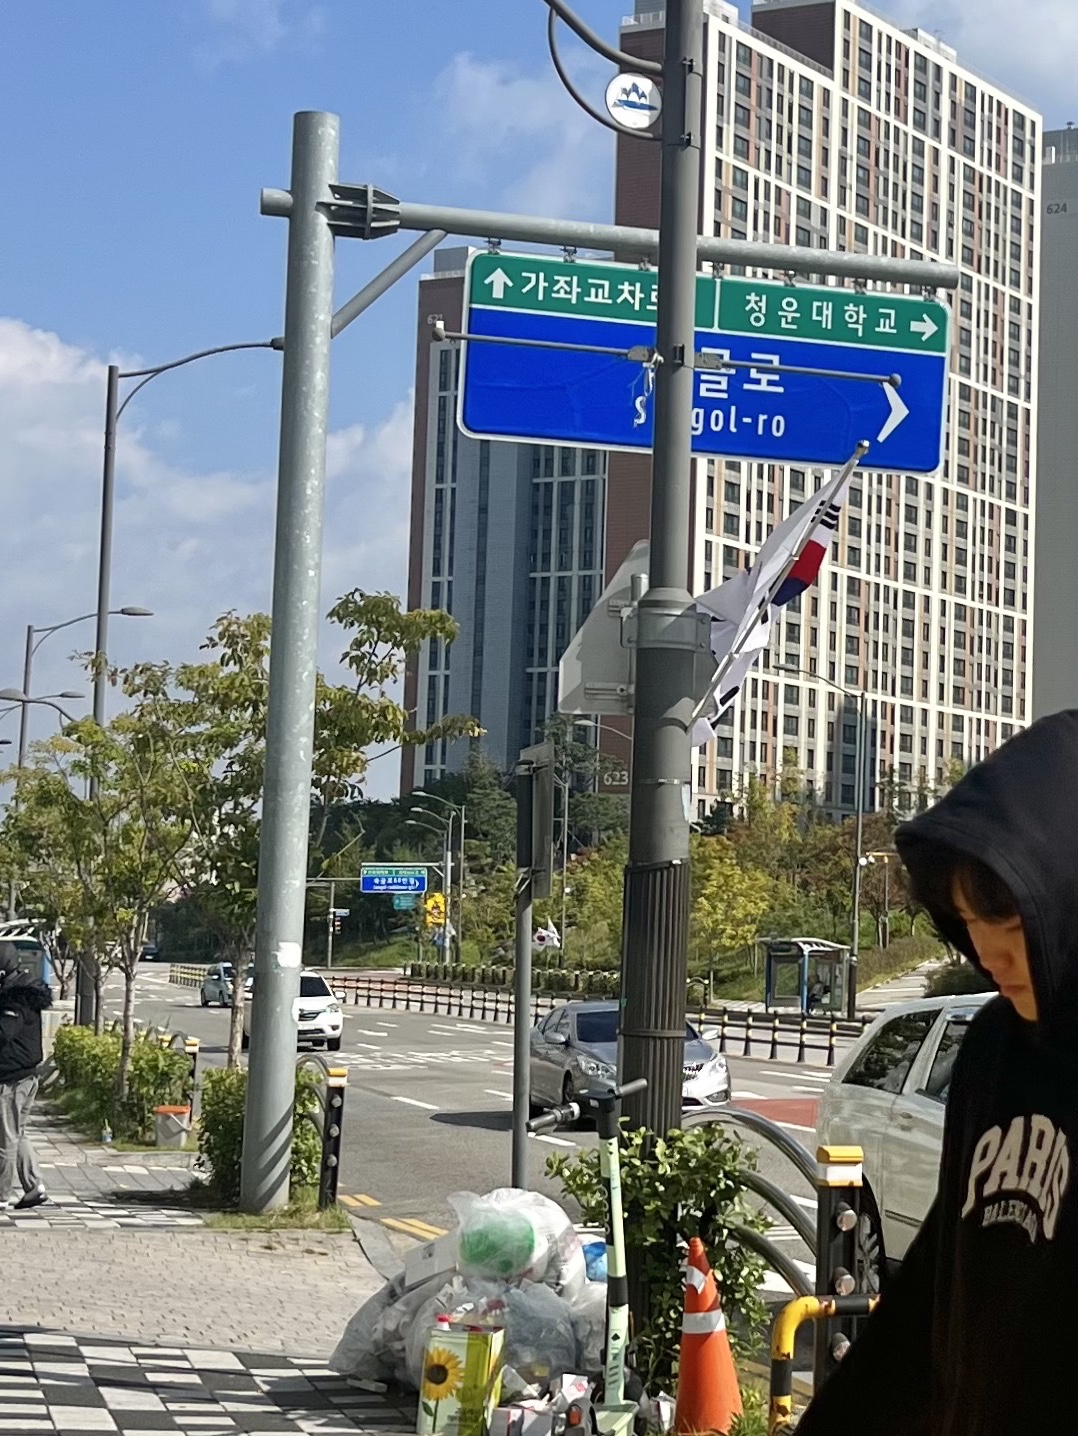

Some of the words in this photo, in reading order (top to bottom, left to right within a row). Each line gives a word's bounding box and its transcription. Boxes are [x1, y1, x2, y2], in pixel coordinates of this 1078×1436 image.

[1046, 202, 1067, 215] 624
[744, 291, 898, 337] 청운대학교
[603, 770, 629, 786] 623
[961, 1113, 1070, 1241] PARIS
